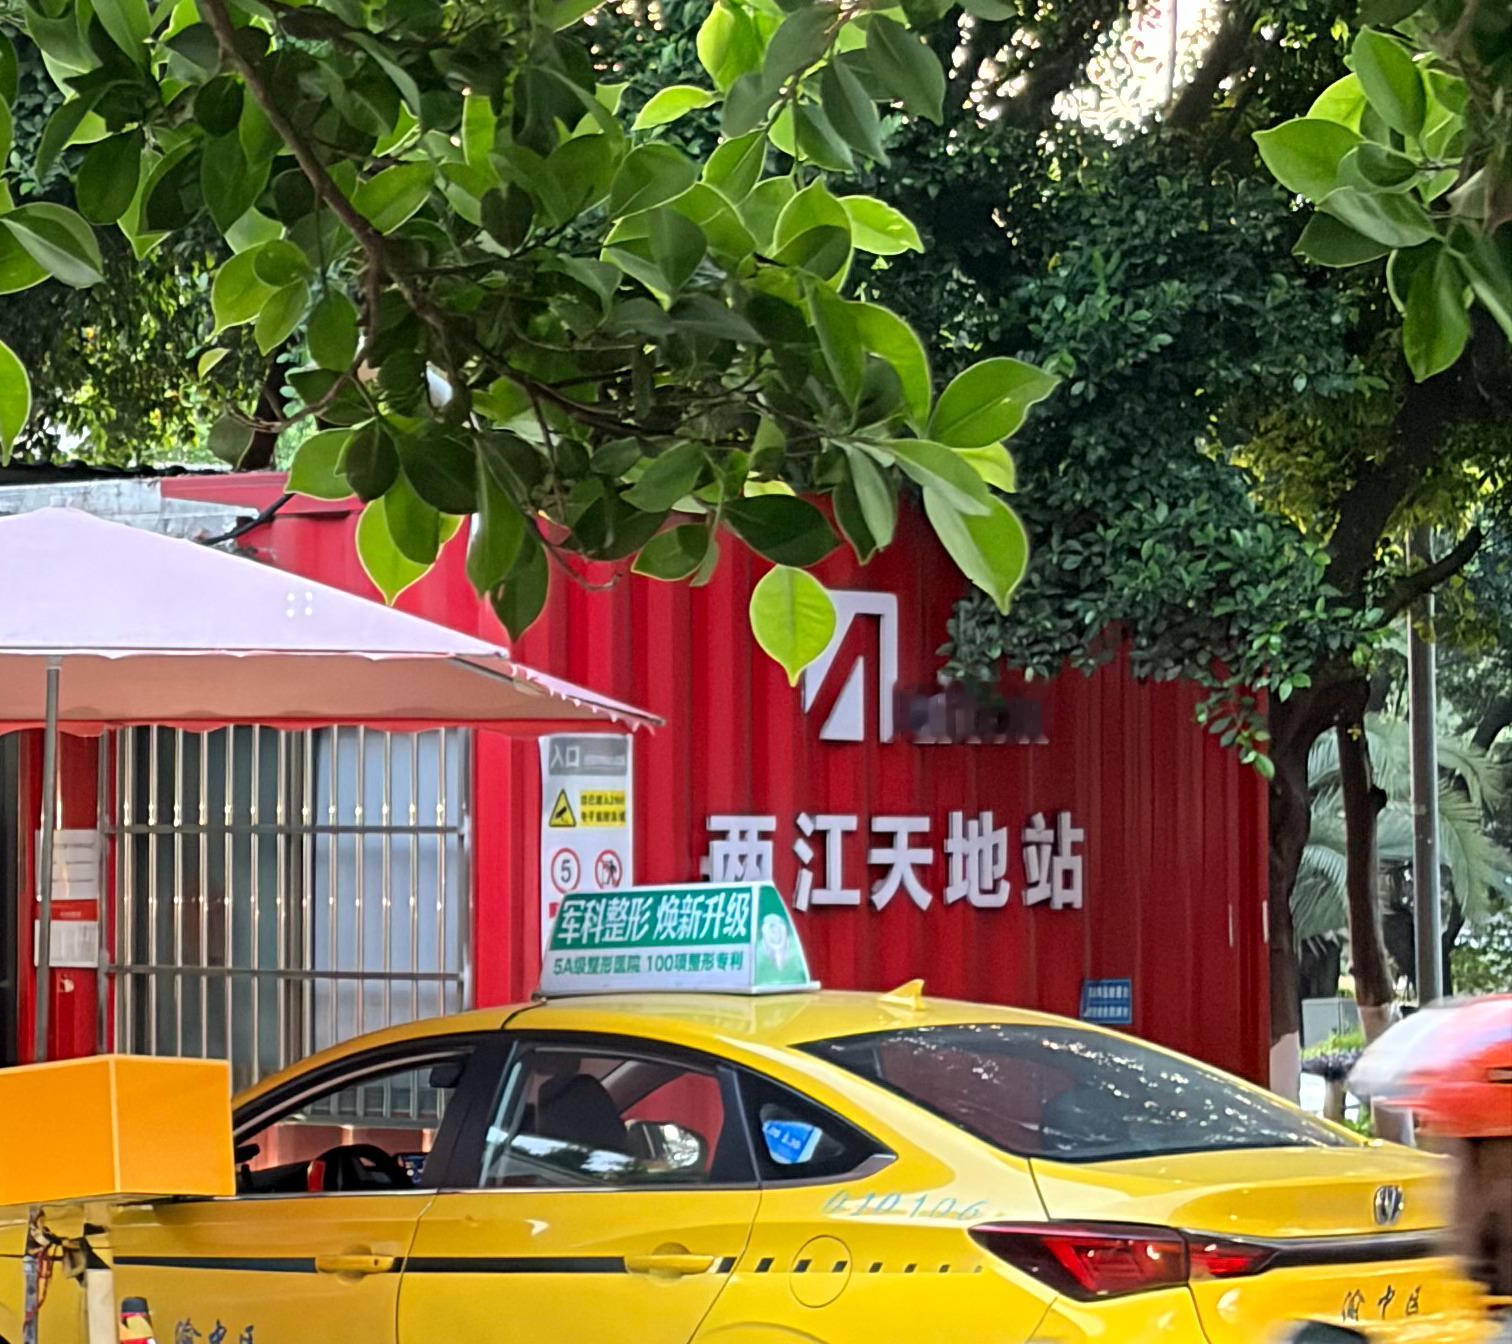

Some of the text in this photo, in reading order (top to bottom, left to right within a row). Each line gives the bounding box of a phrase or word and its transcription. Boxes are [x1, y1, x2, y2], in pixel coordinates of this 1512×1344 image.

[550, 745, 581, 768] 入口
[560, 859, 572, 883] 5
[701, 810, 1084, 913] 两江天地站
[558, 892, 750, 944] 军科整形 焕新升级
